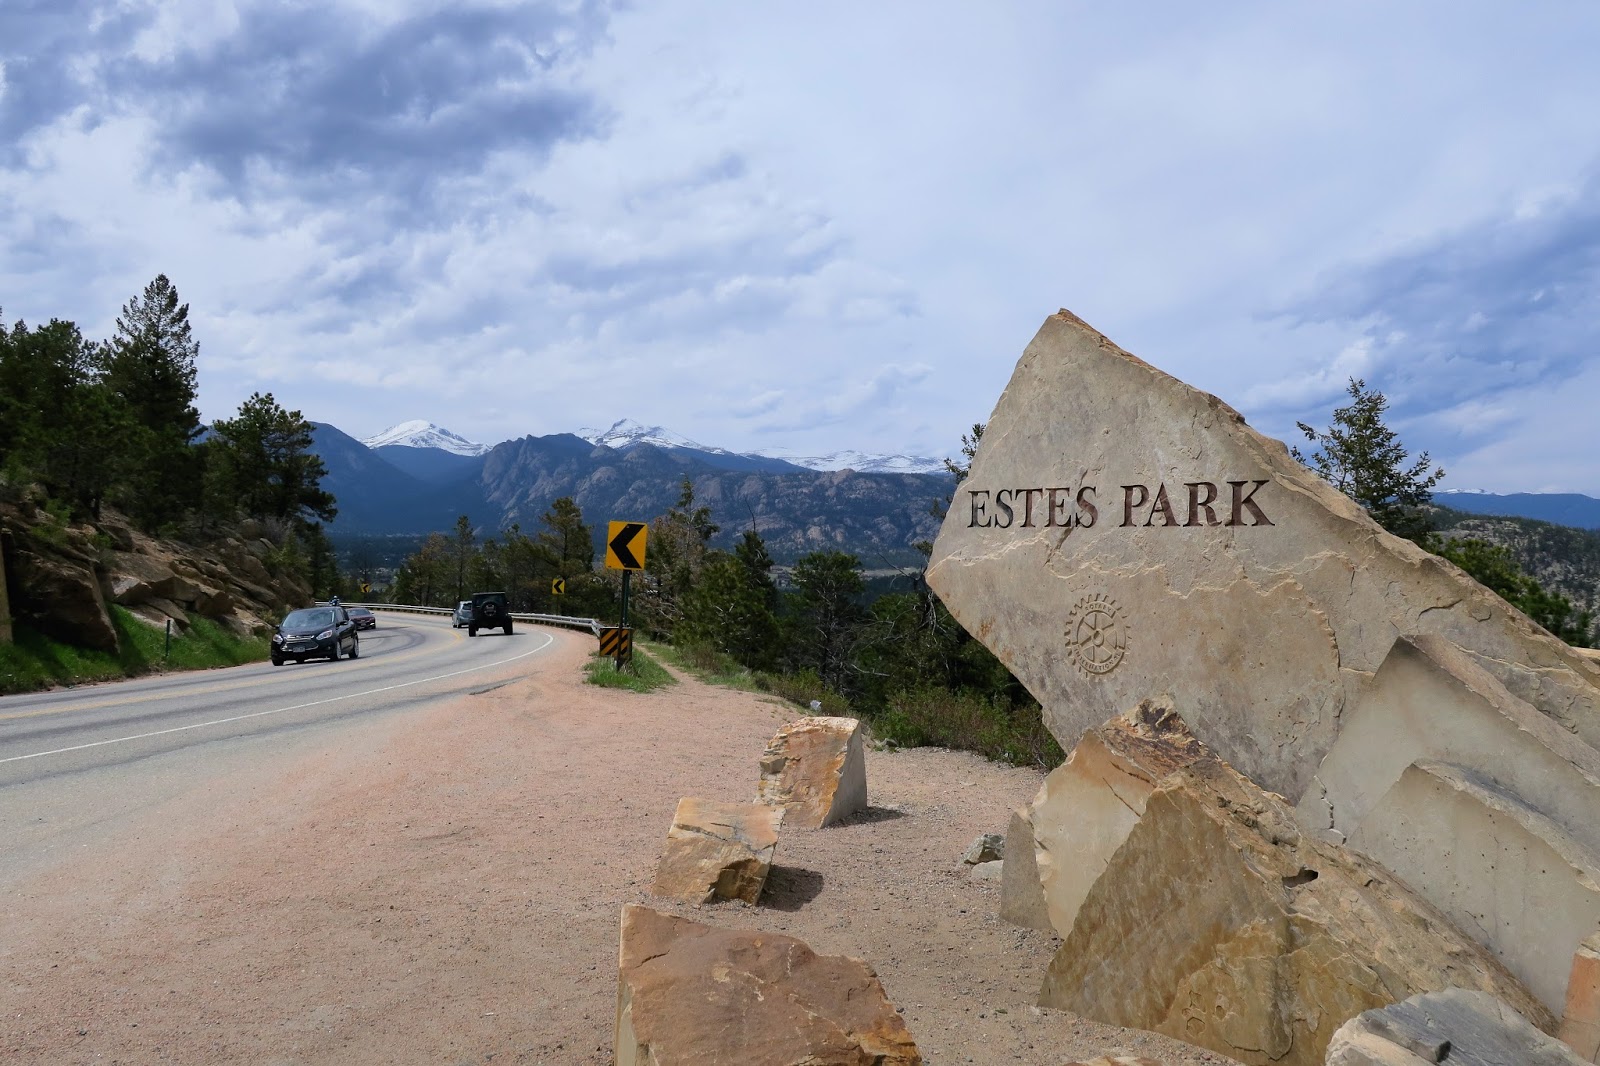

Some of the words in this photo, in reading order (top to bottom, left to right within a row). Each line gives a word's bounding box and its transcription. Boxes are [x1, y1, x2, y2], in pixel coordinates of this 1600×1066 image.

[967, 488, 1098, 528] ESTES
[1119, 480, 1275, 527] PARK
[1085, 603, 1112, 612] ROTARY
